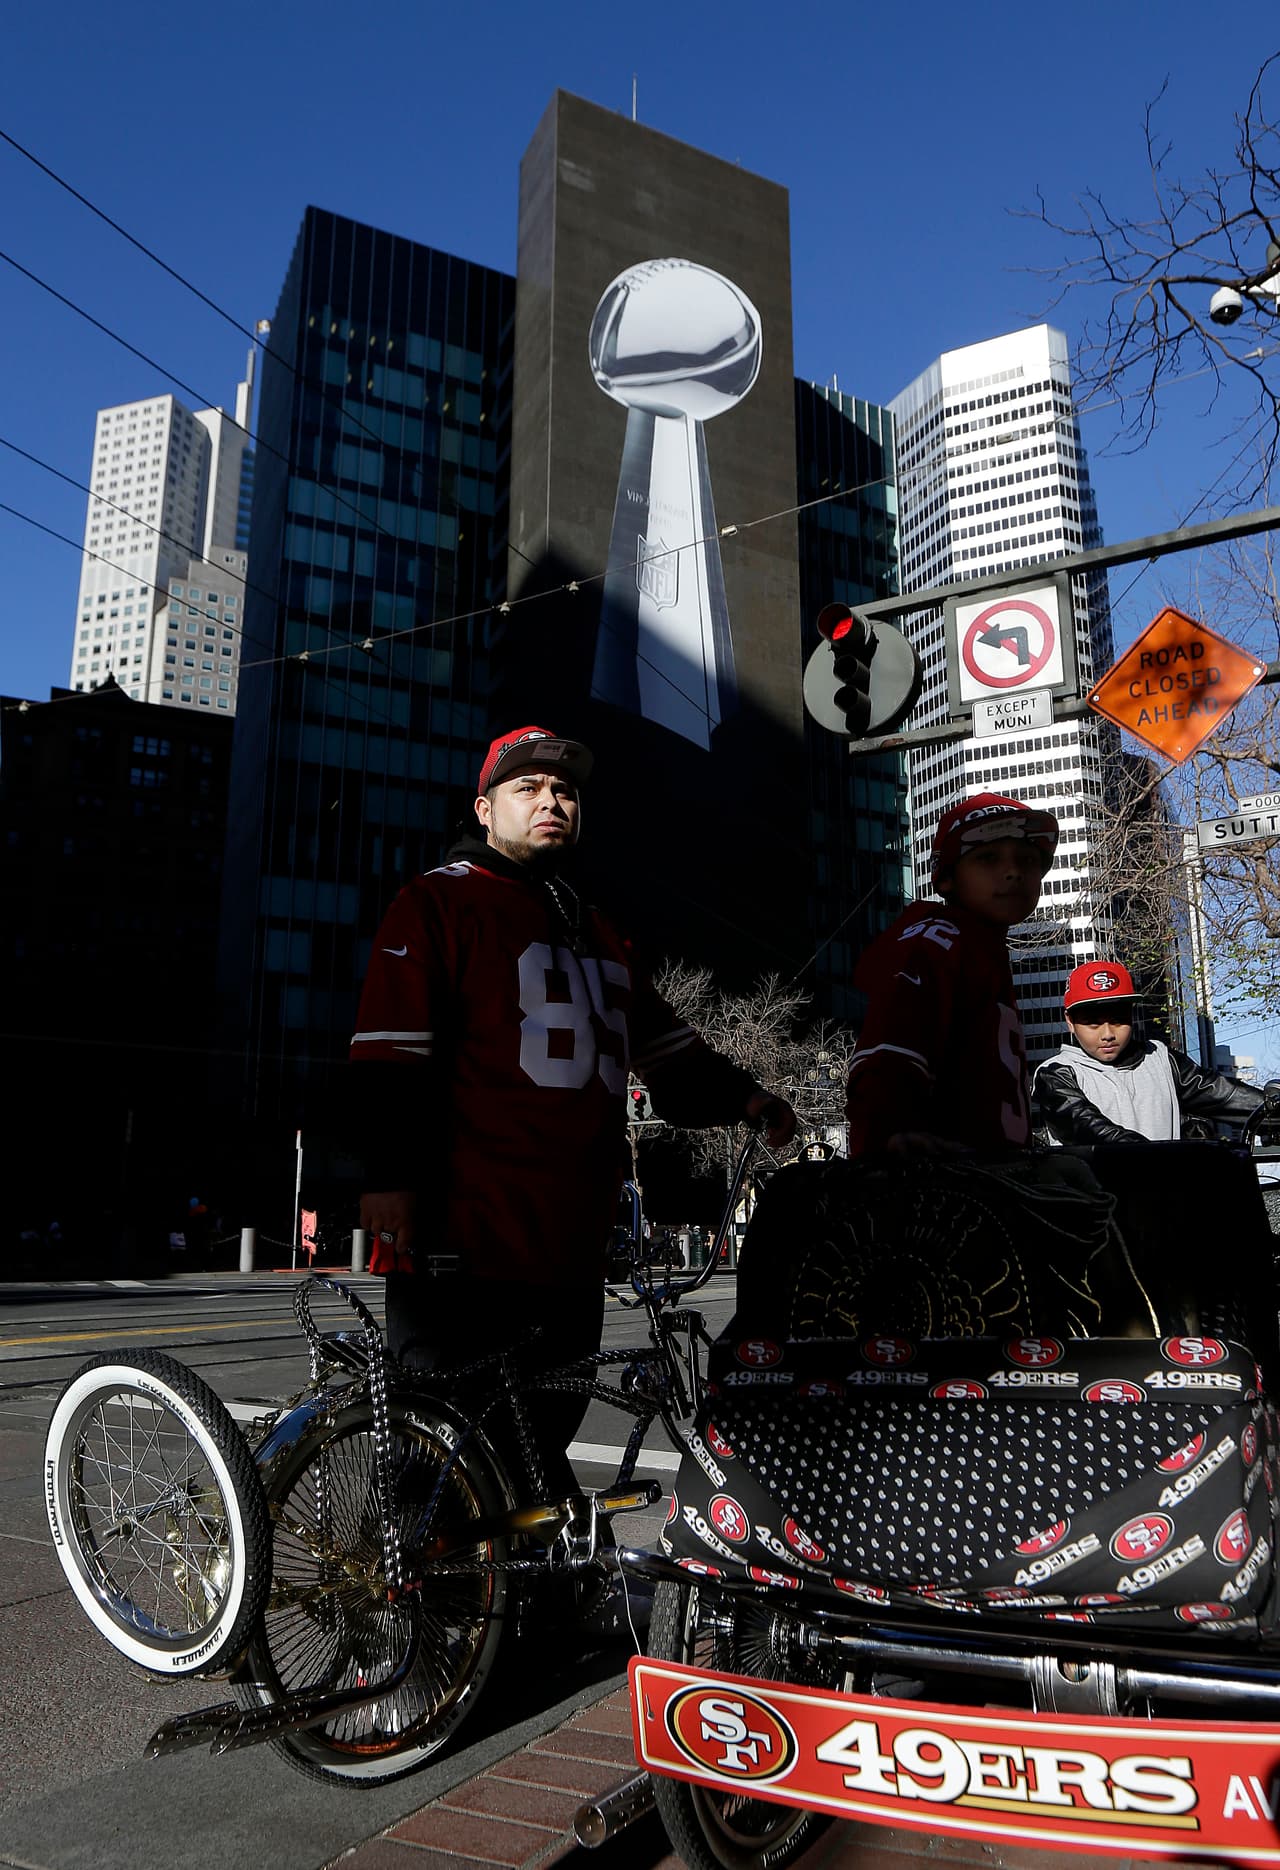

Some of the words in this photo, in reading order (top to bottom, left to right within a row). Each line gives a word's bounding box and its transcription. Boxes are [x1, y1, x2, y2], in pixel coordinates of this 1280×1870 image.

[640, 564, 674, 600] NFL
[1140, 641, 1205, 670] ROAD
[1129, 667, 1221, 698] CLOSED
[986, 697, 1037, 717] EXCEPT
[1137, 697, 1219, 727] AHEAD
[994, 714, 1032, 730] MUNI
[1255, 795, 1280, 808] 000
[1214, 815, 1279, 839] SUTT
[1093, 972, 1115, 991] SF
[517, 942, 633, 1095] 85
[747, 1341, 774, 1364] SF
[875, 1339, 906, 1362] SF
[1020, 1338, 1053, 1363] SF
[1179, 1337, 1217, 1363] SF
[723, 1371, 795, 1386] 49ERS
[846, 1370, 929, 1387] 49ERS
[987, 1370, 1080, 1388] 49ERS
[1144, 1370, 1243, 1391] 49ERS
[1158, 1435, 1238, 1508] 49ERS
[717, 1503, 740, 1536] SF
[1124, 1522, 1164, 1555] SF
[1014, 1533, 1102, 1587] 49ERS
[1116, 1534, 1207, 1594] 49ERS
[699, 1697, 772, 1772] SF
[815, 1719, 1200, 1830] 49ERS
